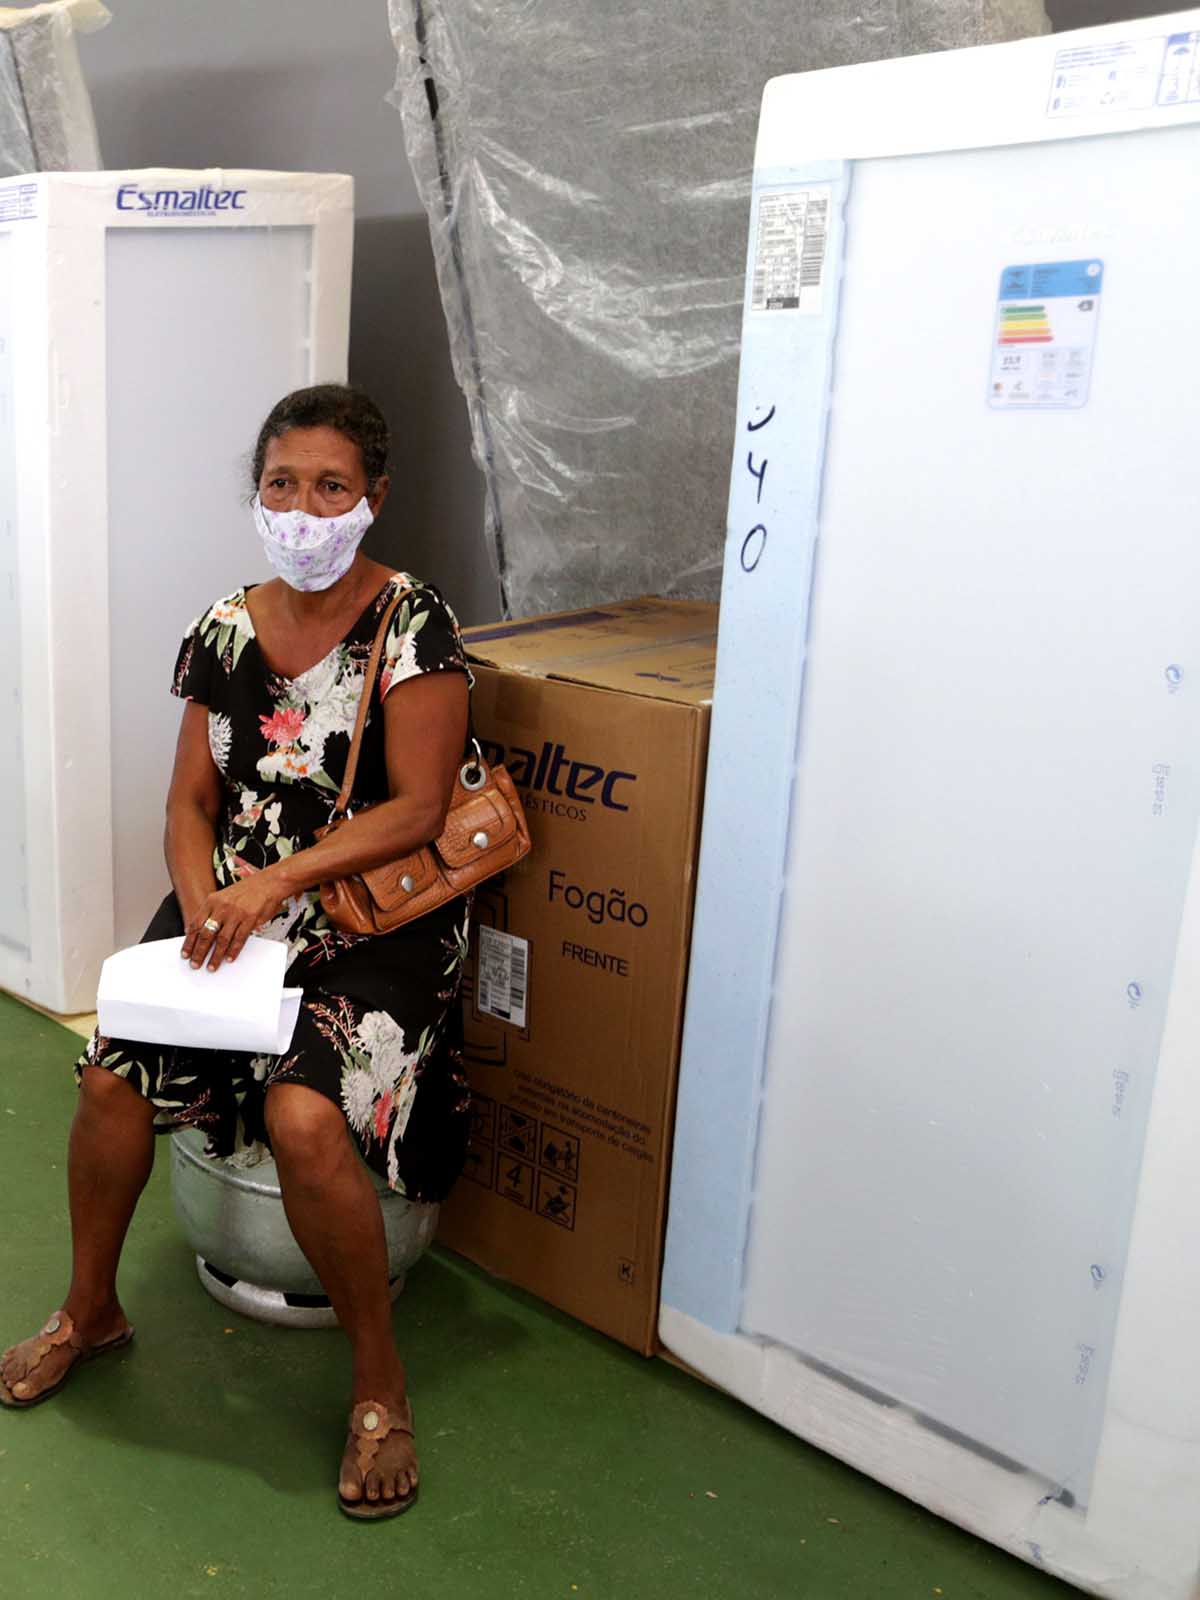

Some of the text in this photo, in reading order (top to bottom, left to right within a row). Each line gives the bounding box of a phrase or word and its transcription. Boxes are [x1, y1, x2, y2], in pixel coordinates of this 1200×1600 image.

[116, 183, 248, 210] Esmaltec
[548, 869, 649, 928] Fogão
[561, 940, 630, 977] FRENTE
